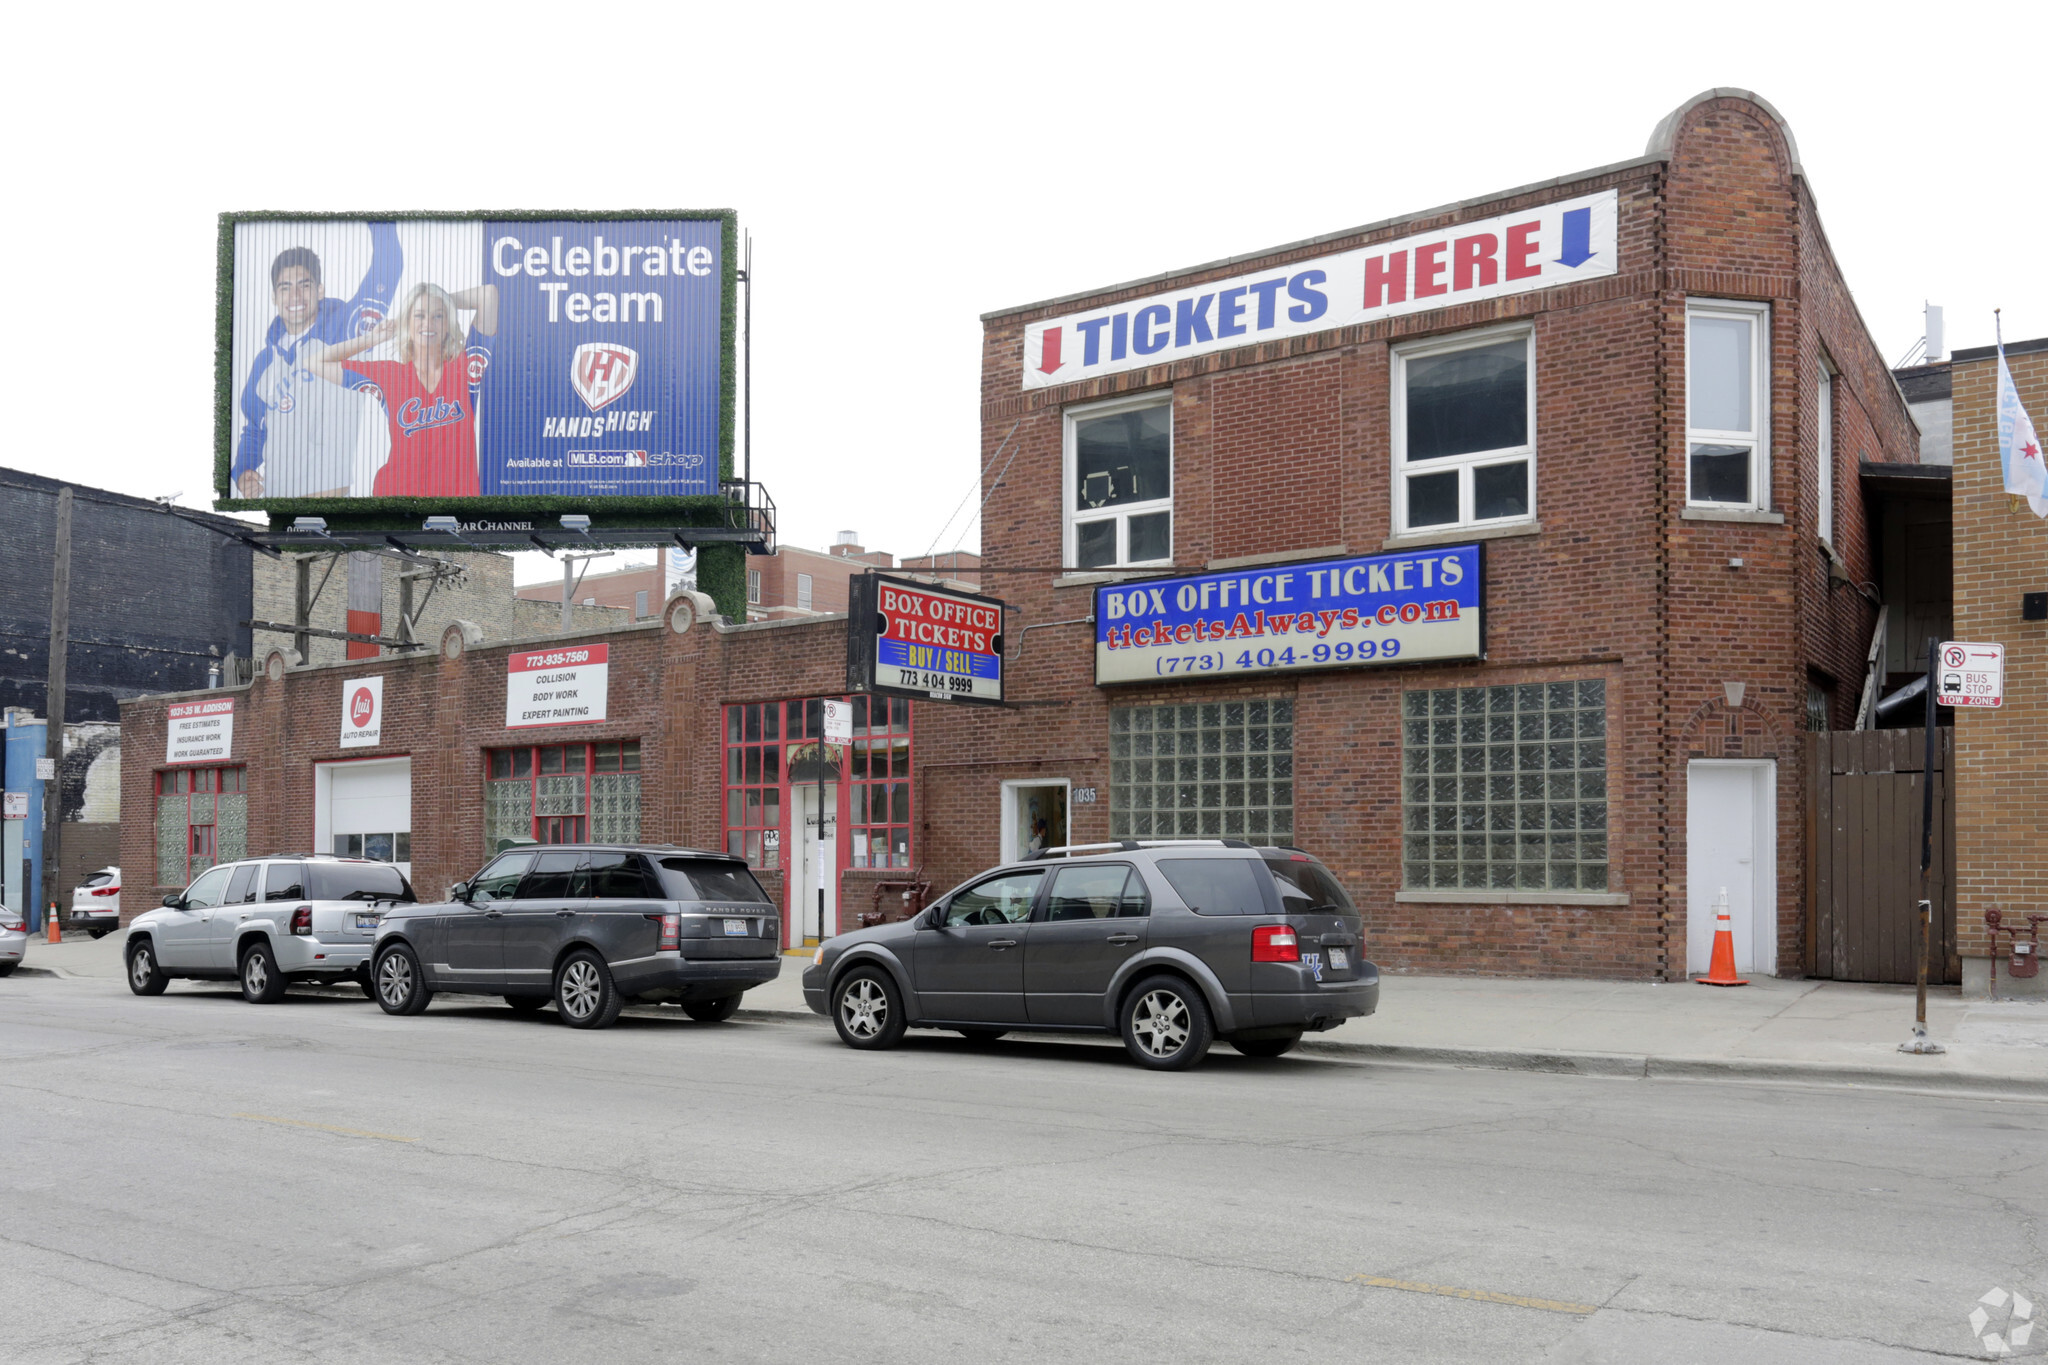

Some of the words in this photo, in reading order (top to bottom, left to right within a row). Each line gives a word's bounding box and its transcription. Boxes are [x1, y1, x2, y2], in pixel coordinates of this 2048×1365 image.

[492, 236, 713, 277] Celebrate
[1076, 269, 1328, 367] TICKETS
[1362, 220, 1542, 309] HERE
[539, 282, 663, 323] Team
[397, 396, 466, 433] Cubs
[507, 457, 551, 468] Available
[552, 458, 563, 468] at
[570, 452, 625, 465] MLB.com
[647, 451, 704, 469] shop
[1107, 588, 1167, 620] BOX
[1176, 574, 1294, 612] OFFICE
[1306, 556, 1463, 599] TICKETS
[884, 590, 924, 617] BOX
[929, 600, 996, 630] OFFICE
[1106, 599, 1460, 651] ticketsAlways.com
[895, 618, 985, 651] TICKETS
[526, 650, 589, 667] 773-935-7560
[909, 645, 933, 669] BUY
[945, 650, 972, 674] SELL
[1156, 651, 1224, 676] (773)
[1235, 638, 1401, 668] 404-9999
[536, 672, 576, 684] COLLISION
[900, 670, 918, 686] 773
[923, 673, 945, 689] 404
[949, 677, 973, 693] 9999
[1966, 673, 1988, 684] BUS
[532, 692, 554, 701] BODY
[555, 689, 578, 699] WORK
[1965, 684, 1993, 695] STOP
[353, 695, 370, 719] Luis
[1942, 695, 1964, 704] TOW
[1968, 696, 1996, 706] ZONE
[170, 706, 193, 717] 1031-35
[193, 704, 202, 714] W.
[202, 702, 233, 714] ADDISON
[522, 710, 551, 720] EXPERT
[552, 706, 589, 717] PAINTING
[179, 722, 192, 730] FREE
[192, 719, 221, 729] ESTIMATES
[176, 735, 205, 744] INSURANCE
[205, 733, 222, 741] WORK
[343, 731, 358, 740] AUTO
[358, 729, 379, 738] REPAIR
[173, 750, 188, 758] WORK
[189, 747, 224, 757] GUARANTEED
[1073, 787, 1096, 803] 1035
